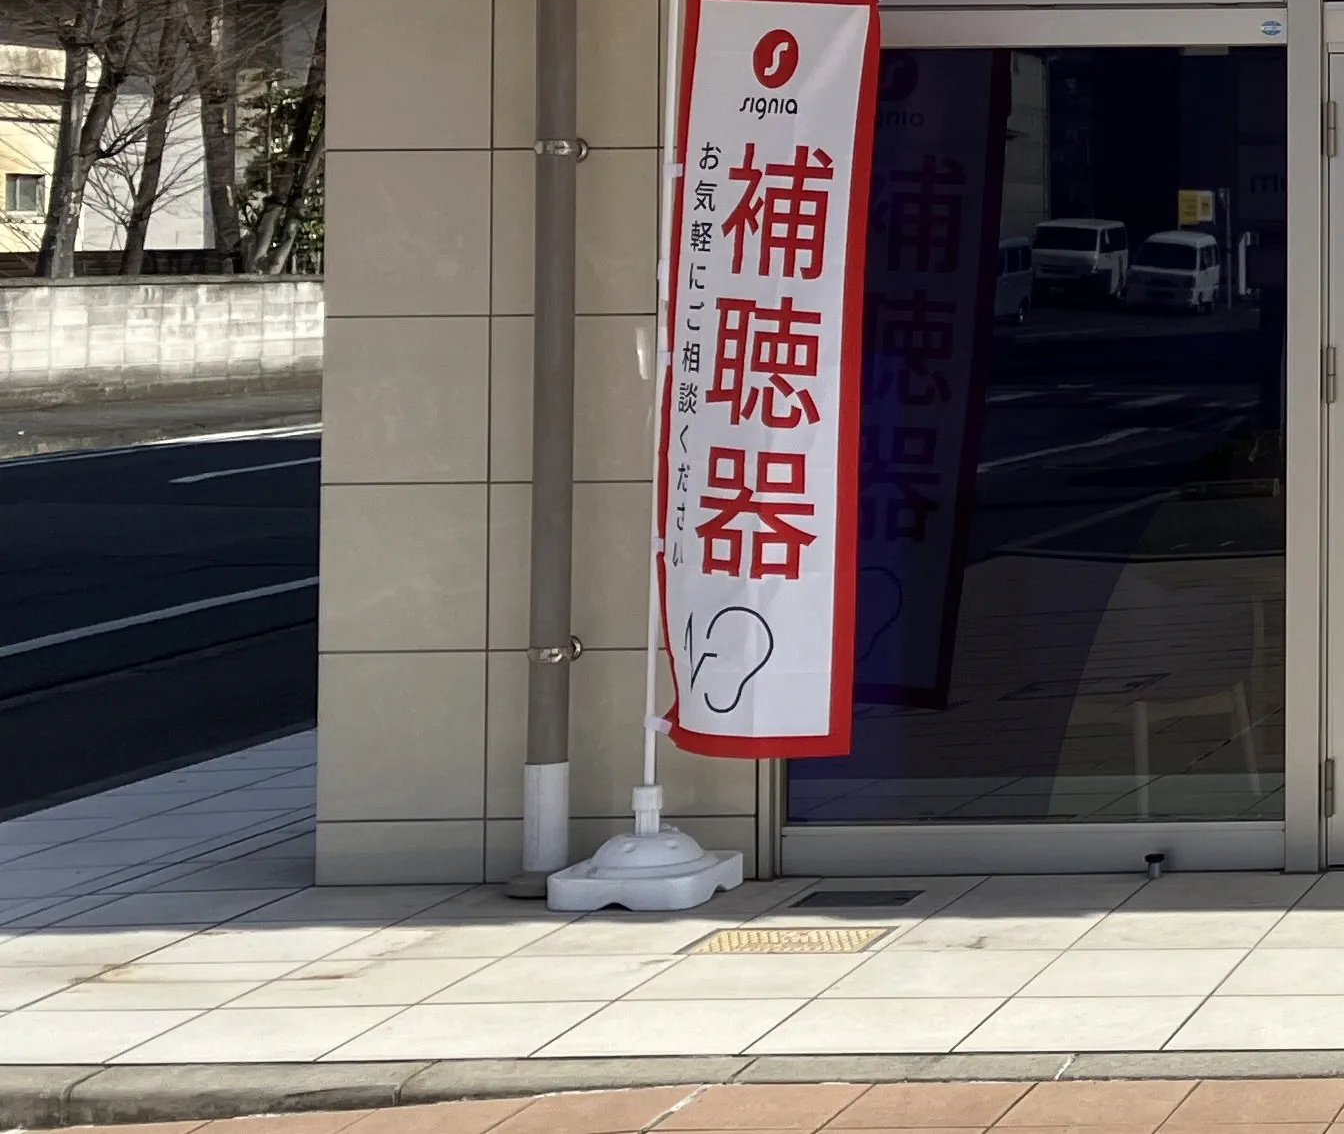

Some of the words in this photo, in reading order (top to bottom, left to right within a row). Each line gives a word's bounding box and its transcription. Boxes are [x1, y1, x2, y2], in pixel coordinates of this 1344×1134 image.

[739, 97, 798, 119] signia
[672, 141, 721, 567] お気軽にご相談ください
[695, 142, 834, 581] 補聴器
